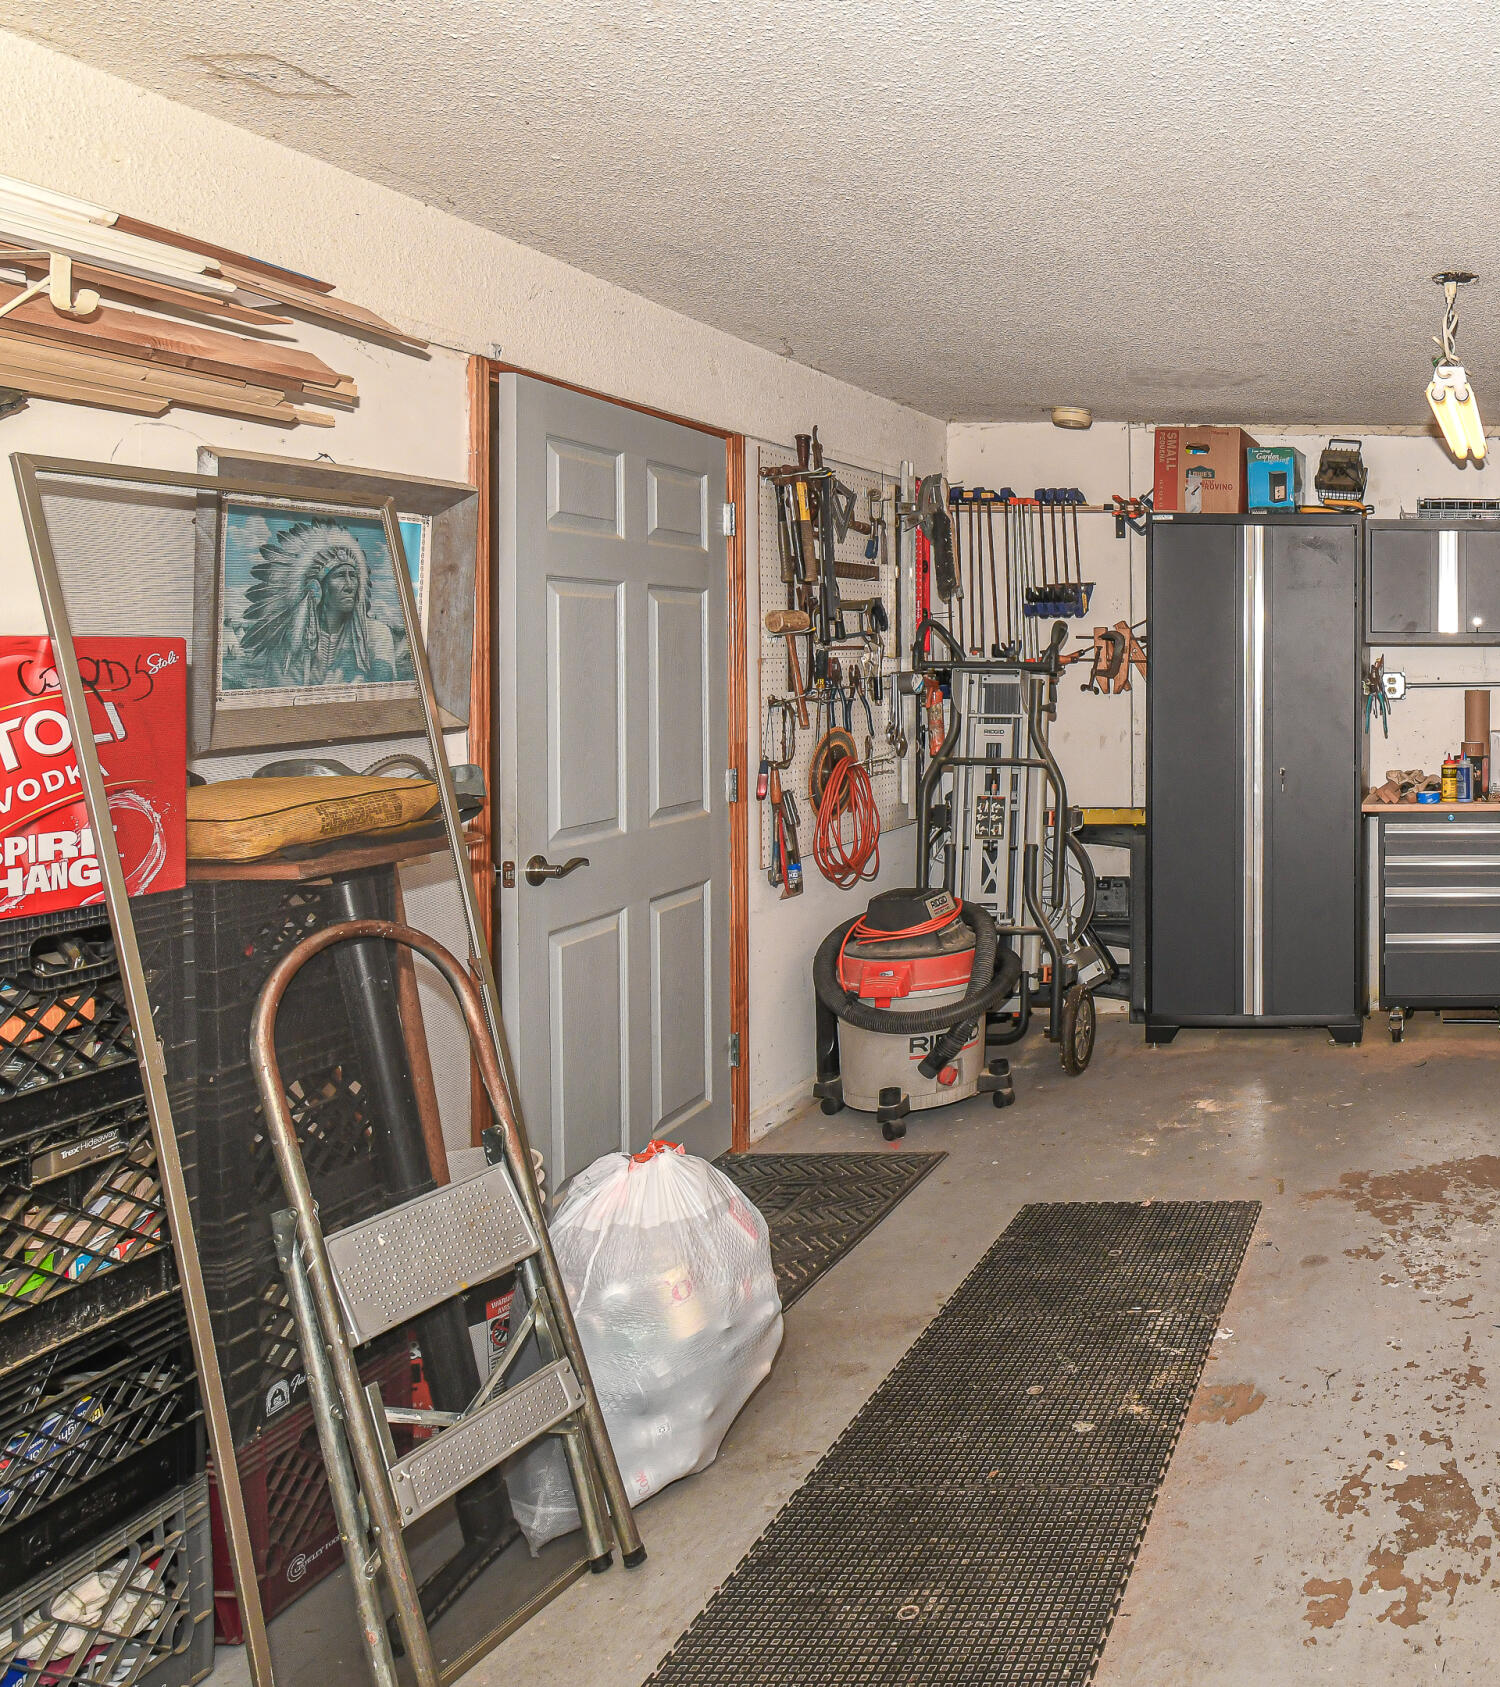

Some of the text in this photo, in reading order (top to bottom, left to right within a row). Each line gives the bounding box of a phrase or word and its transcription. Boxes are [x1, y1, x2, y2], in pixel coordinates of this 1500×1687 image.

[1166, 432, 1178, 471] SMALL
[147, 651, 177, 674] Stoli
[60, 1128, 119, 1159] Trex Hideaway
